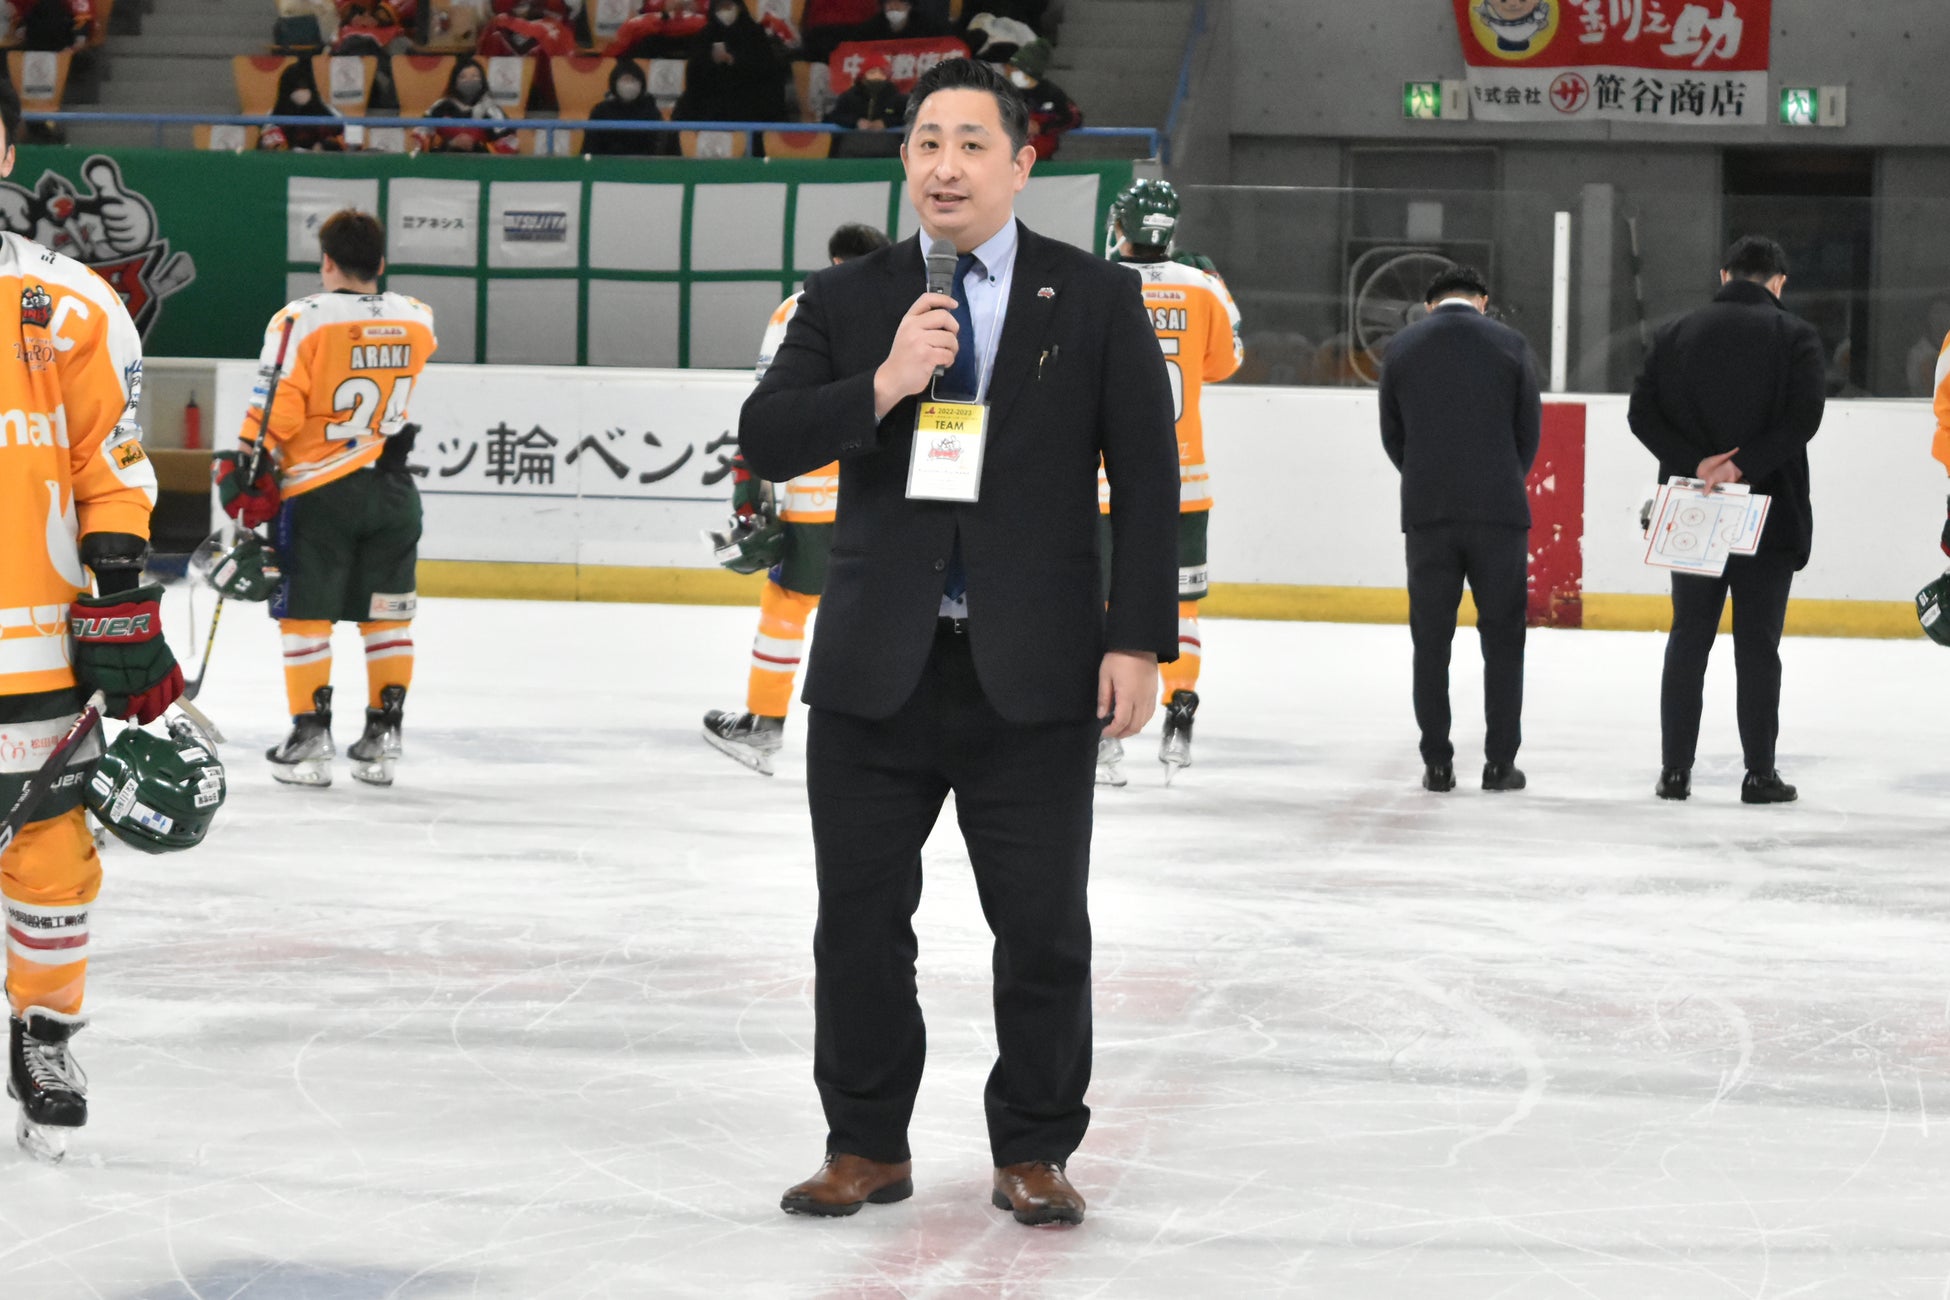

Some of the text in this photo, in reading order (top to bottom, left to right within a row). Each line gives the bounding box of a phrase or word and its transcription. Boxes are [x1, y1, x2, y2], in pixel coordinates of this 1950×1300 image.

[1593, 73, 1747, 117] 笹谷商店
[51, 295, 89, 352] C
[351, 344, 411, 370] ARAKI
[935, 420, 964, 431] TEAM
[405, 421, 739, 486] ツ輪ベンタ
